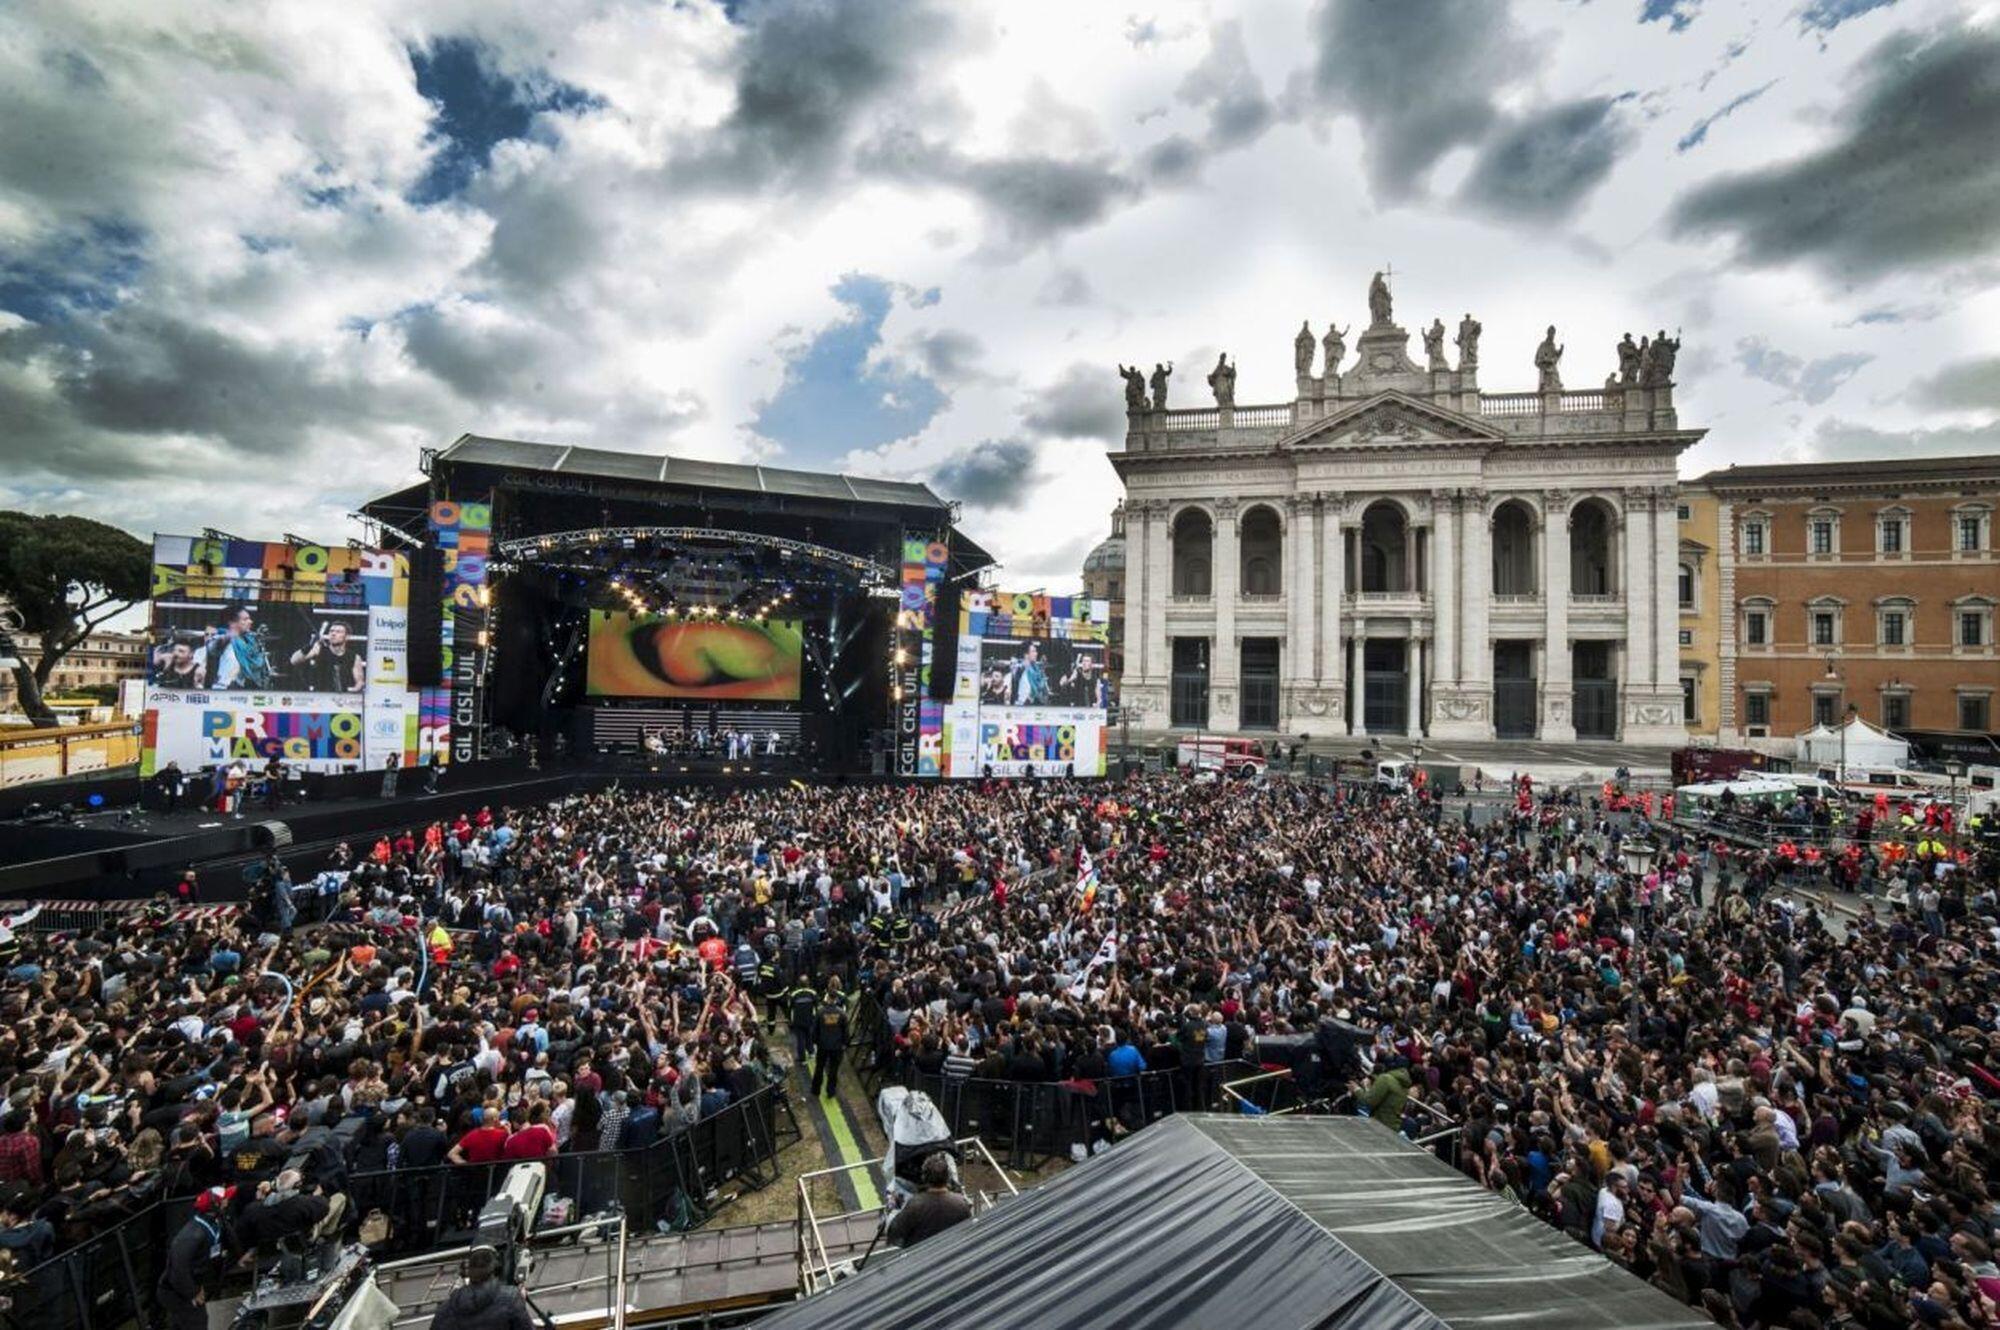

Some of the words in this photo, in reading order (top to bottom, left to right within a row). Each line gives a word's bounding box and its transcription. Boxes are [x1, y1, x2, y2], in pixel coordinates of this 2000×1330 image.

[455, 504, 488, 609] 2016
[459, 651, 475, 681] UIL
[904, 668, 917, 693] UIL
[457, 688, 473, 726] CISL
[903, 700, 916, 733] CISL
[203, 711, 360, 739] PRIMO
[982, 724, 1075, 745] PRIMO
[202, 736, 360, 759] MAGGIO
[901, 738, 915, 776] CGIL
[982, 743, 1075, 760] MAGGIO
